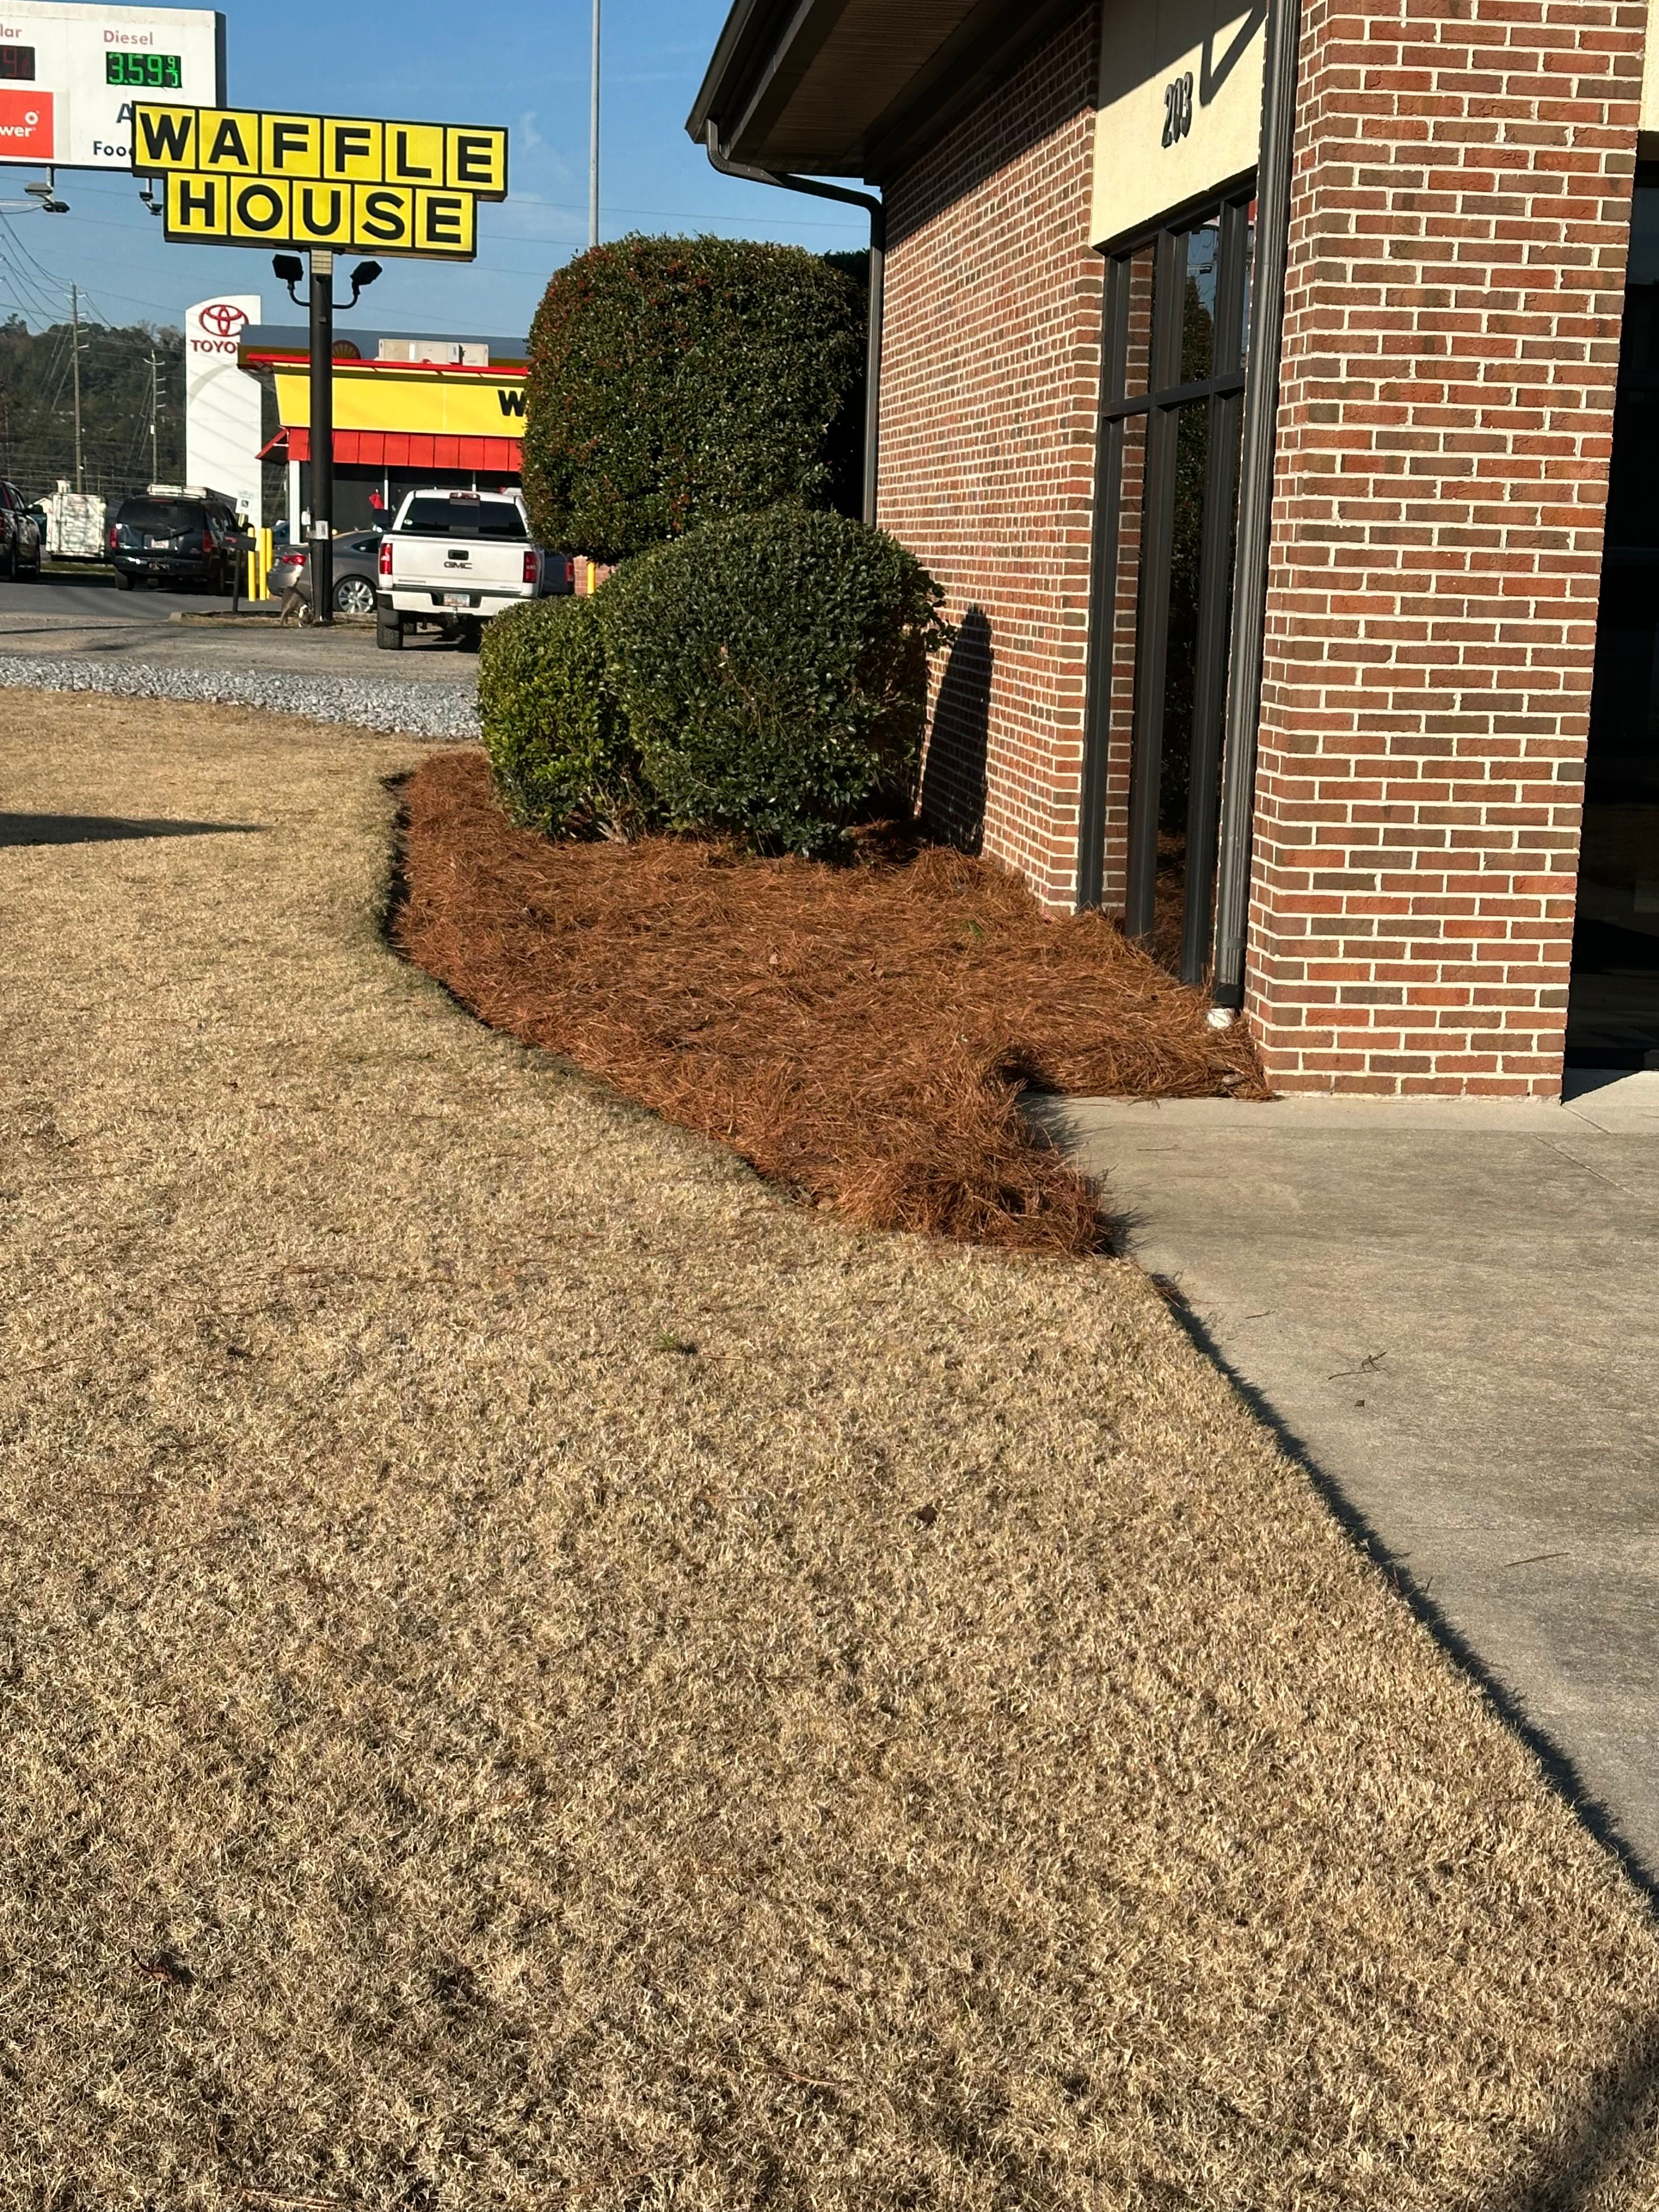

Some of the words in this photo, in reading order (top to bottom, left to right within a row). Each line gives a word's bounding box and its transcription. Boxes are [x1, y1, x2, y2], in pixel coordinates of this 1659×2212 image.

[103, 30, 153, 45] Diesel
[1161, 71, 1193, 149] 203
[93, 140, 132, 156] Foo
[139, 112, 493, 183] WAFFLE
[179, 179, 462, 244] HOUSE
[190, 340, 240, 354] TOYO
[444, 561, 472, 569] GMC
